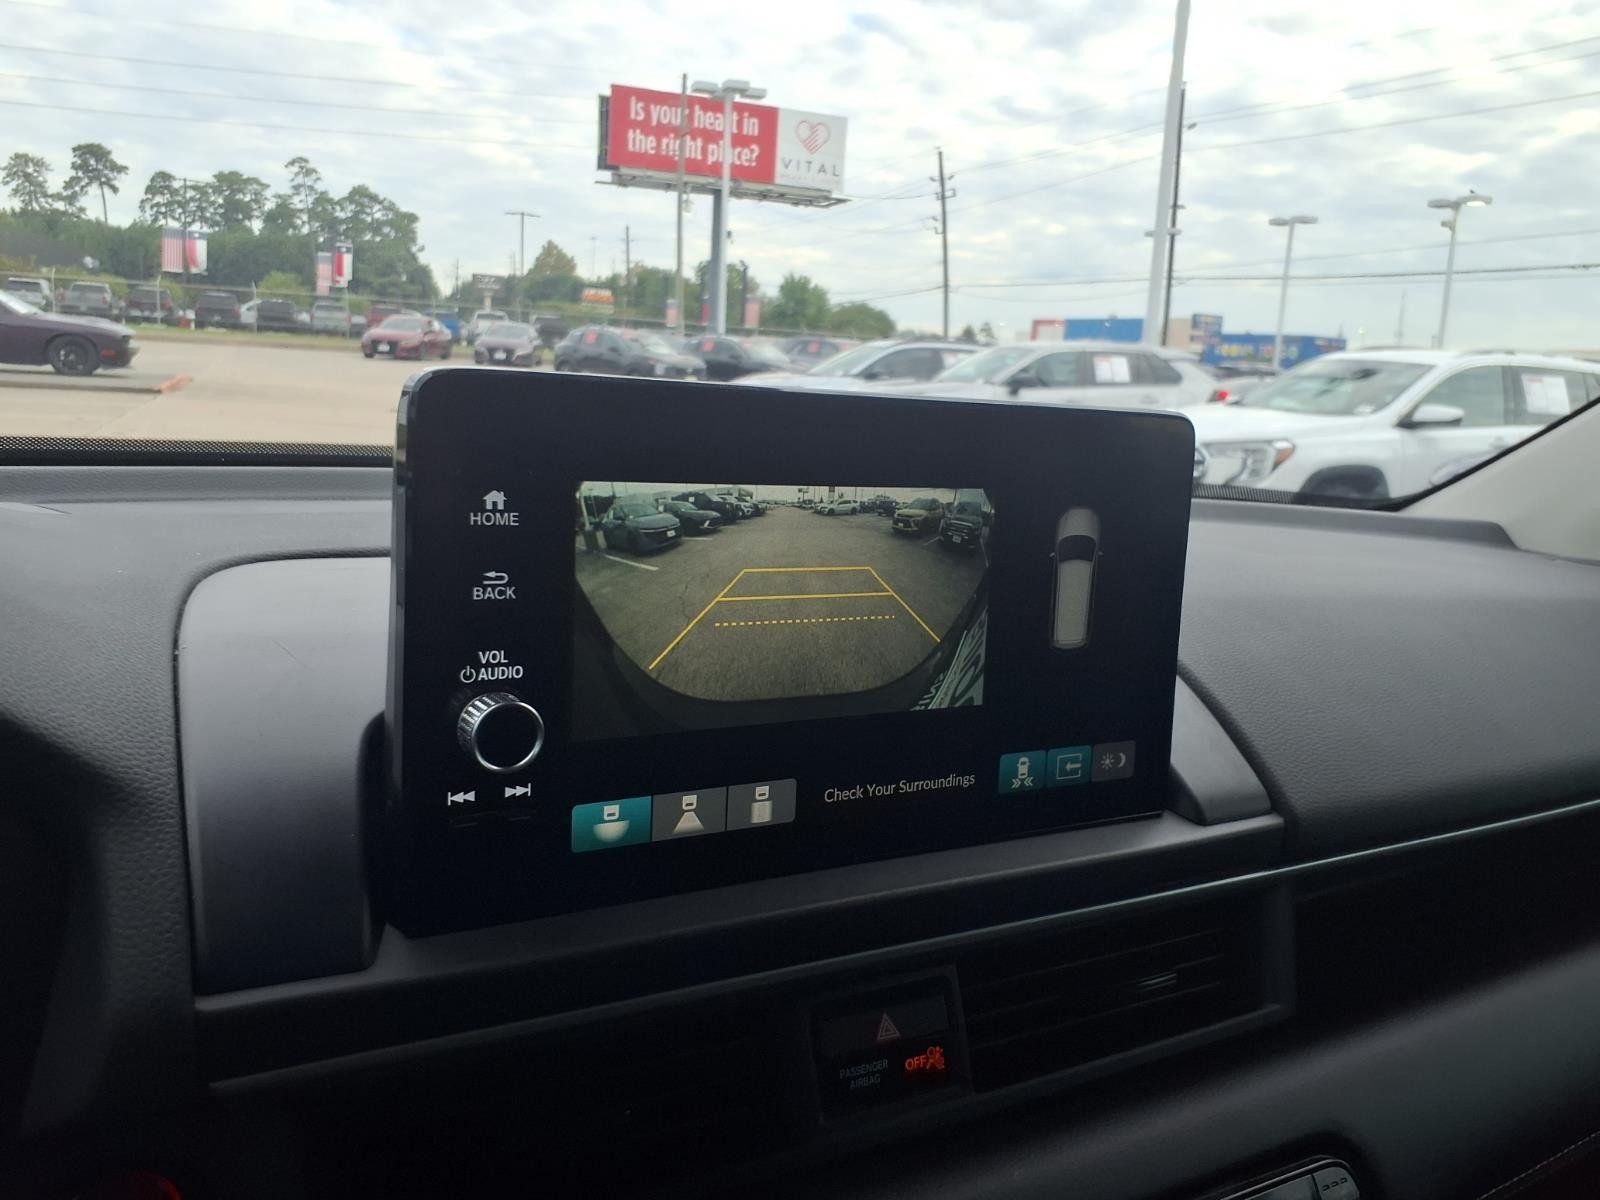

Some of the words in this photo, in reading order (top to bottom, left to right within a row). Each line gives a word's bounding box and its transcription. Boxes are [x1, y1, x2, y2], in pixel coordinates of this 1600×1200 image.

[630, 96, 645, 120] Is
[695, 106, 739, 132] heat
[743, 113, 759, 136] in
[627, 128, 656, 155] the
[707, 141, 760, 166] plce?
[782, 158, 840, 177] VITAL
[469, 512, 520, 527] HOME
[472, 586, 517, 601] BACK
[477, 650, 509, 664] VOL
[477, 665, 524, 681] AUDIO
[824, 785, 864, 802] Check
[867, 782, 897, 798] Your
[898, 773, 976, 793] Surroundings
[839, 1058, 889, 1080] PASSENGER
[904, 1054, 927, 1071] OFF
[850, 1073, 881, 1089] AIRBAG
